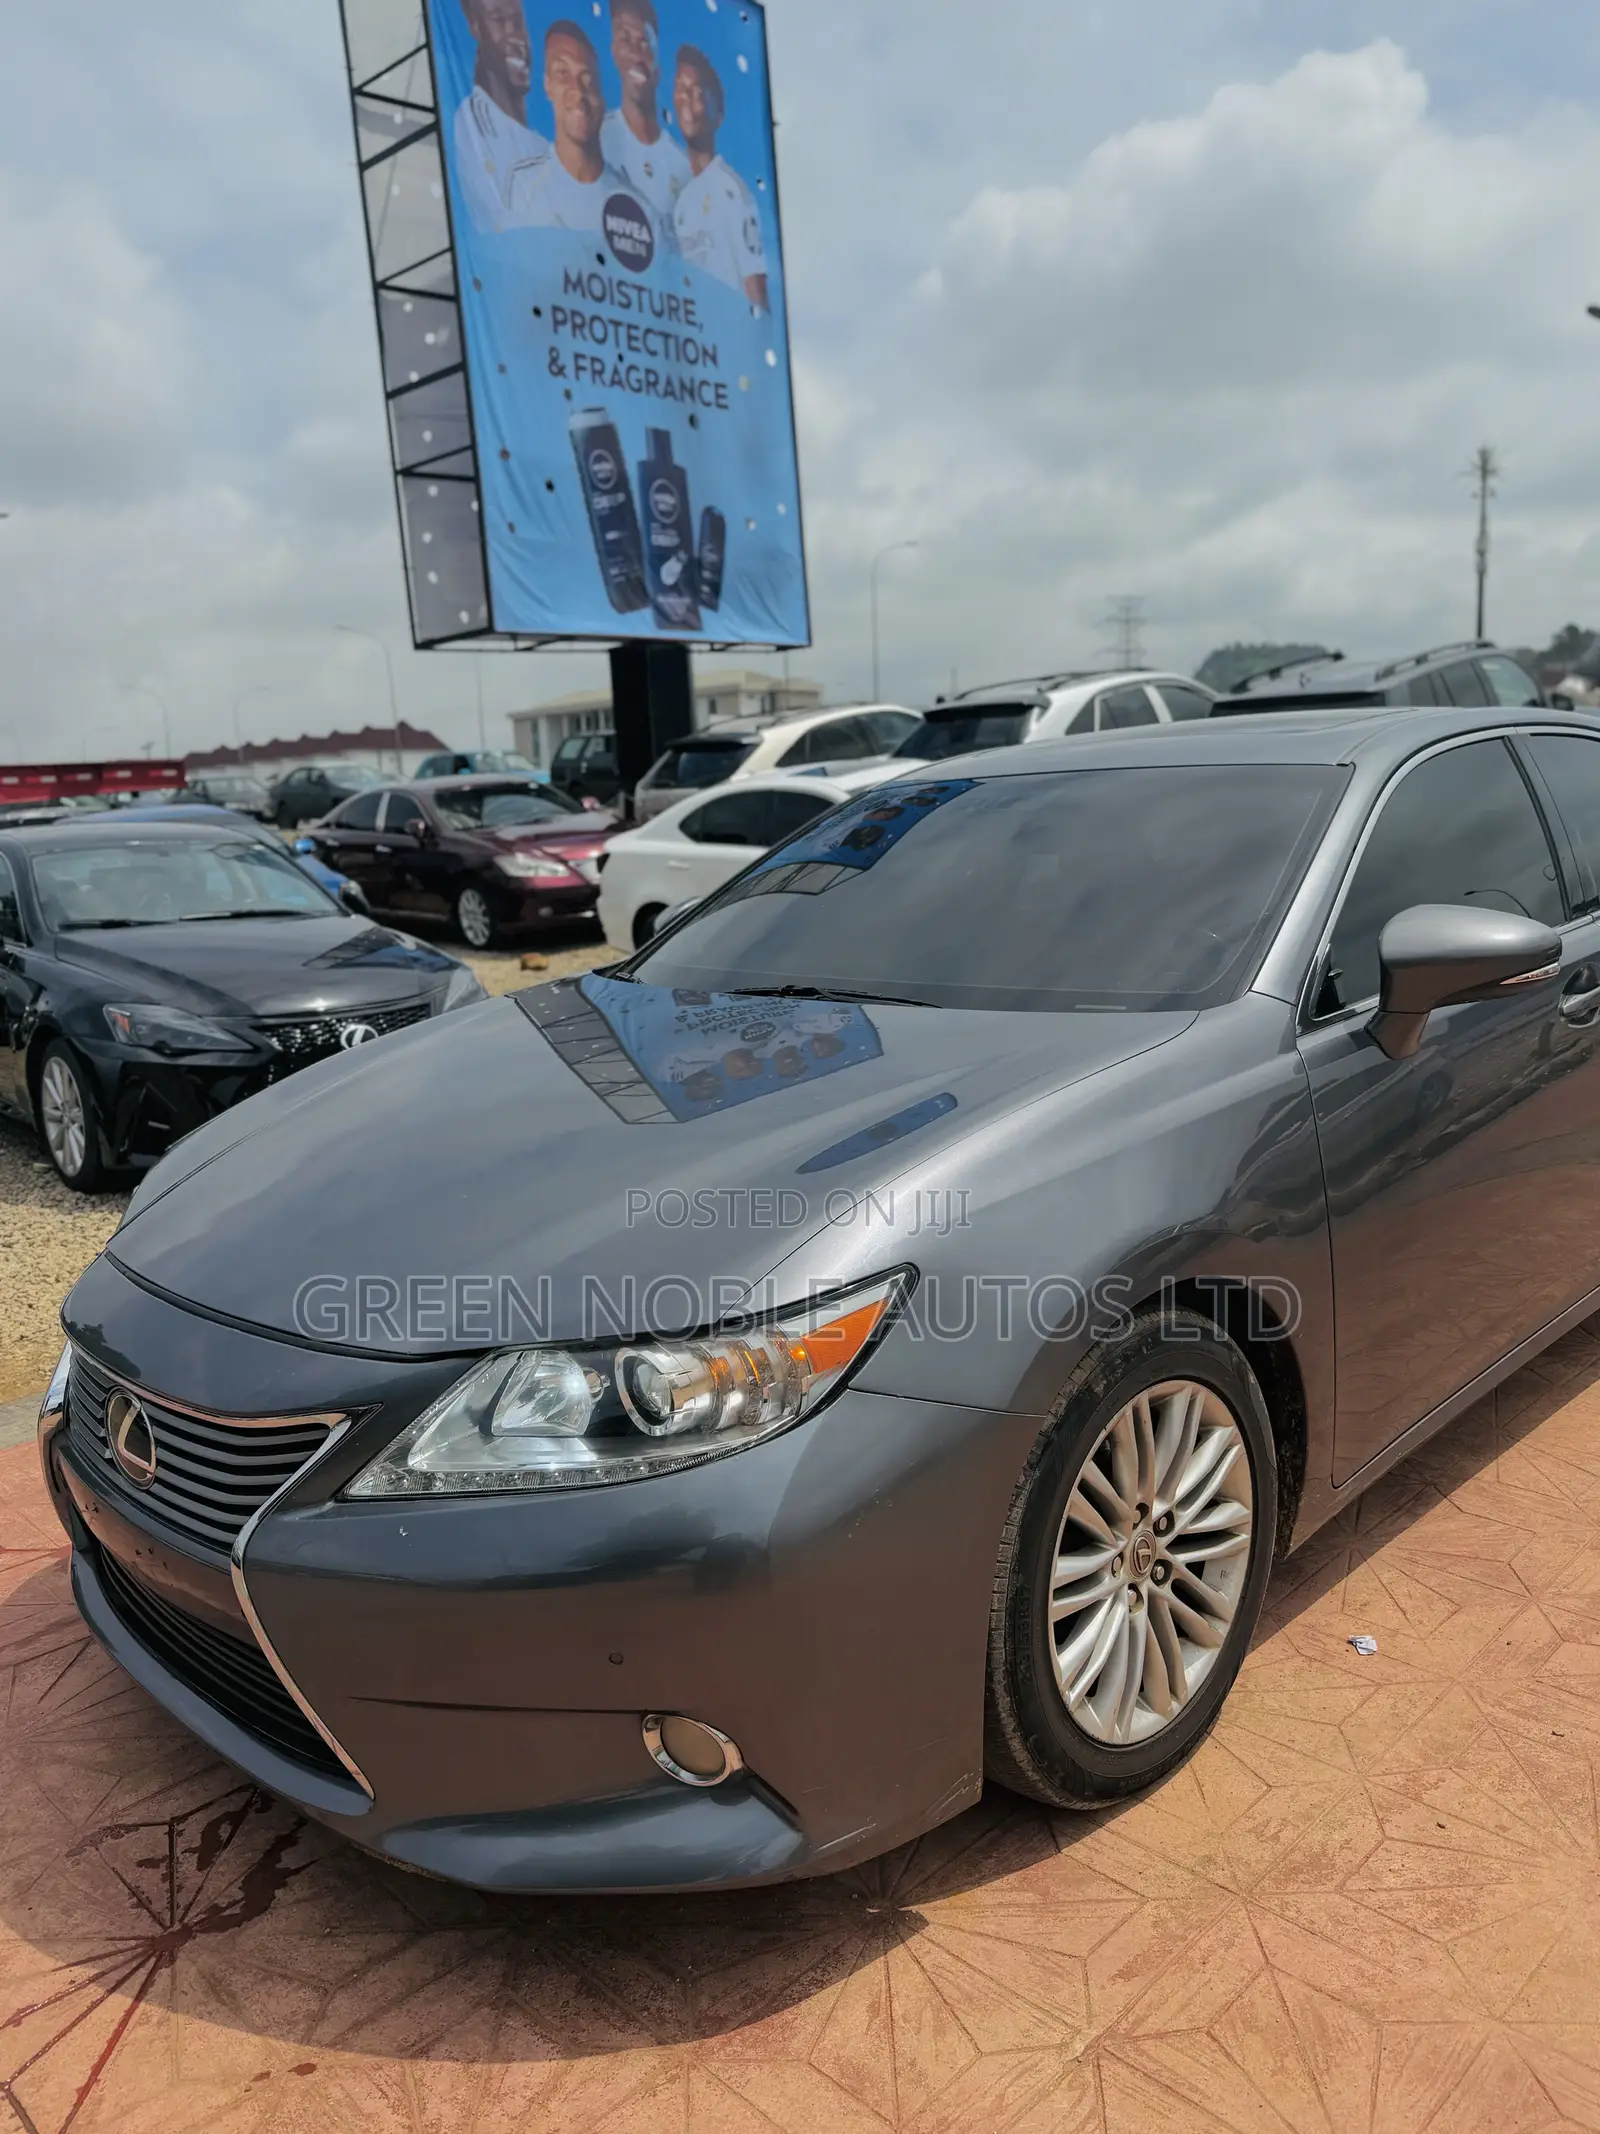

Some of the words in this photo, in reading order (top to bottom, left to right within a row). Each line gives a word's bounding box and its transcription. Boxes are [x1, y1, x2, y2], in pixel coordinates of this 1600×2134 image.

[606, 213, 652, 244] NIVEA
[563, 267, 703, 332] MOISTURE,
[551, 305, 718, 368] PROTECTION
[548, 347, 567, 378] &
[573, 352, 729, 410] FRAGRANCE
